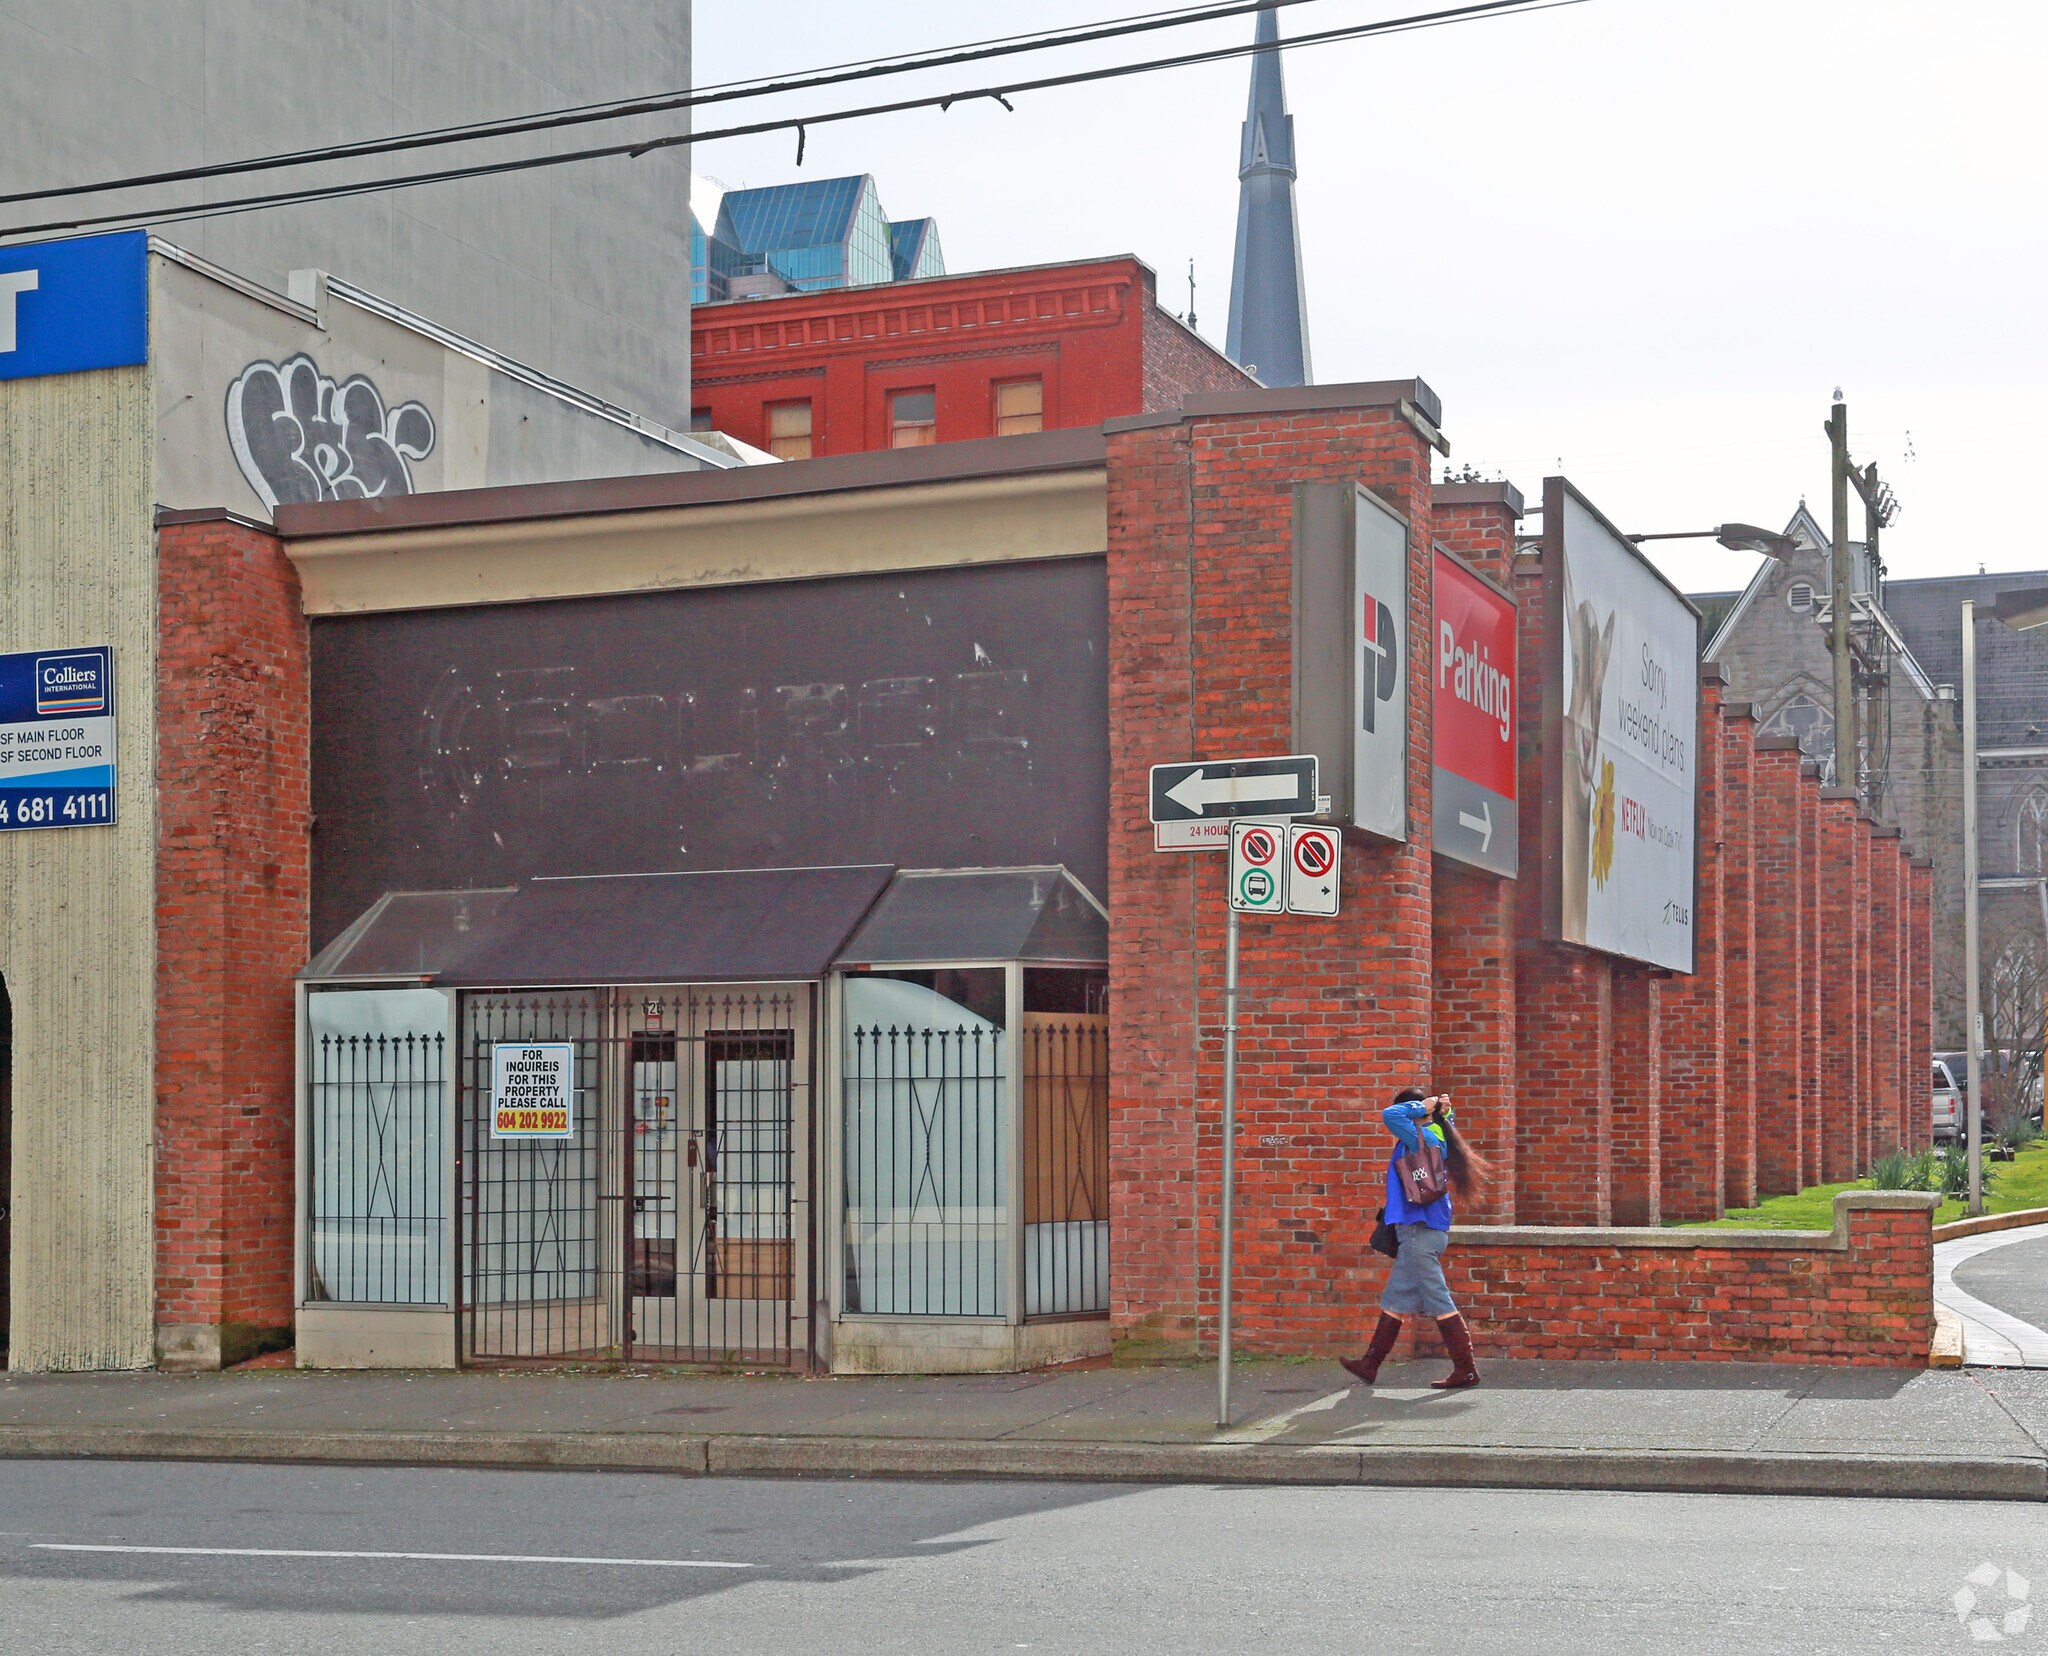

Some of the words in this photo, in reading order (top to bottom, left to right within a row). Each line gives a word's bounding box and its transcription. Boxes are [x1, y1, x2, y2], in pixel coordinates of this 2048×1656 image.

[43, 666, 97, 685] Colliers
[1440, 618, 1510, 742] Parking
[1641, 642, 1667, 710] Sorry,
[44, 683, 97, 693] INTERNATIONAL
[1618, 696, 1660, 754] weekend
[0, 732, 14, 745] SF
[17, 730, 45, 744] MAIN
[48, 728, 85, 742] FLOOR
[0, 751, 14, 763] SF
[17, 748, 62, 762] SECOND
[65, 745, 102, 759] FLOOR
[17, 797, 54, 823] 681
[63, 793, 107, 819] 4111
[1621, 795, 1646, 843] NETFLIX
[1190, 826, 1201, 837] 24
[1672, 903, 1688, 926] TELUS
[522, 1050, 543, 1060] FOR
[506, 1061, 560, 1072] INQUIREIS
[508, 1075, 529, 1085] FOR
[532, 1075, 556, 1085] THIS
[505, 1086, 560, 1096] PROPERTY
[498, 1098, 537, 1108] PLEASE
[540, 1098, 567, 1108] CALL
[497, 1112, 516, 1129] 604
[519, 1112, 538, 1129] 202
[541, 1112, 567, 1129] 9922
